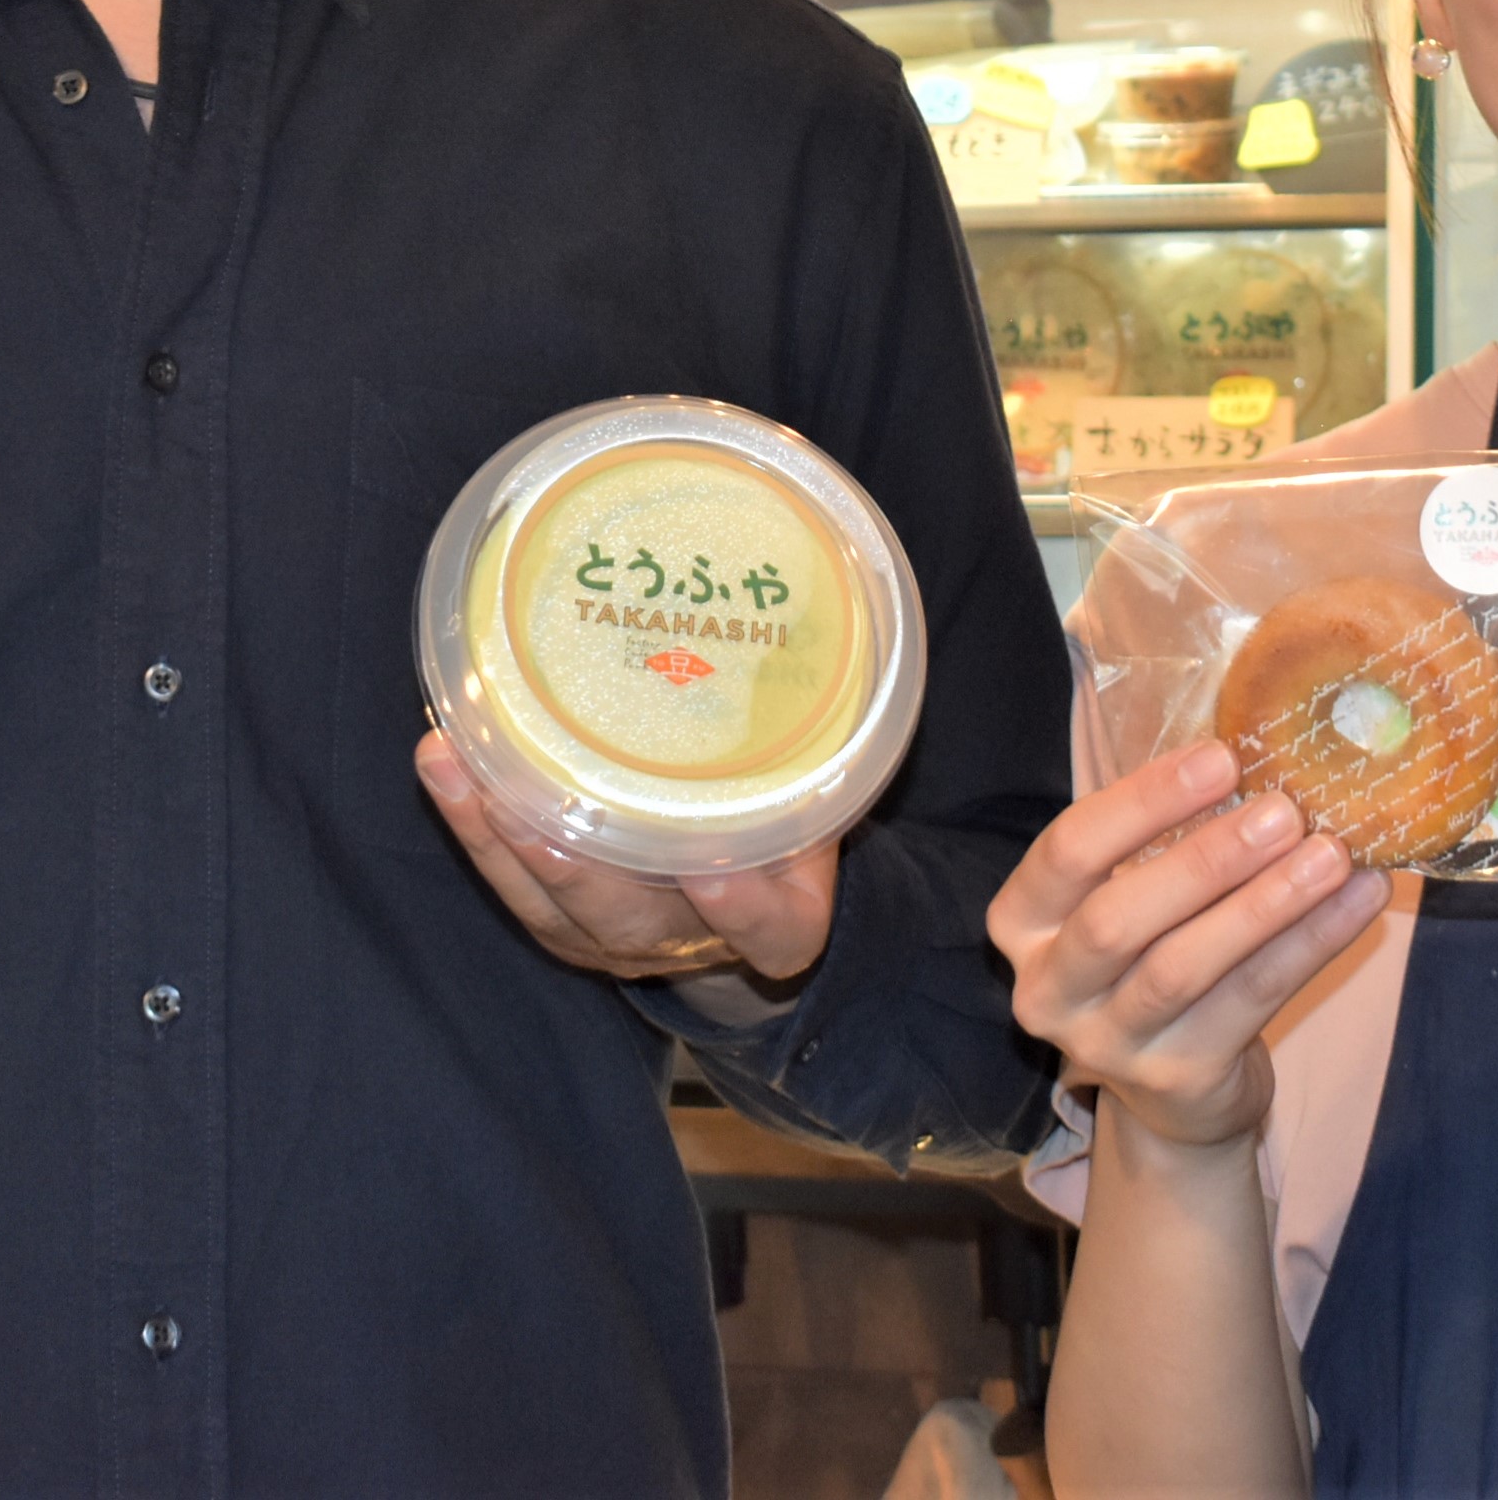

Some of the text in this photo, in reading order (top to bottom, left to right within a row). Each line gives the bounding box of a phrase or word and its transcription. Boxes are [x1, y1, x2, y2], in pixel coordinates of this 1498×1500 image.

[576, 543, 790, 610] とうふや
[575, 598, 787, 647] TAKAHASHI
